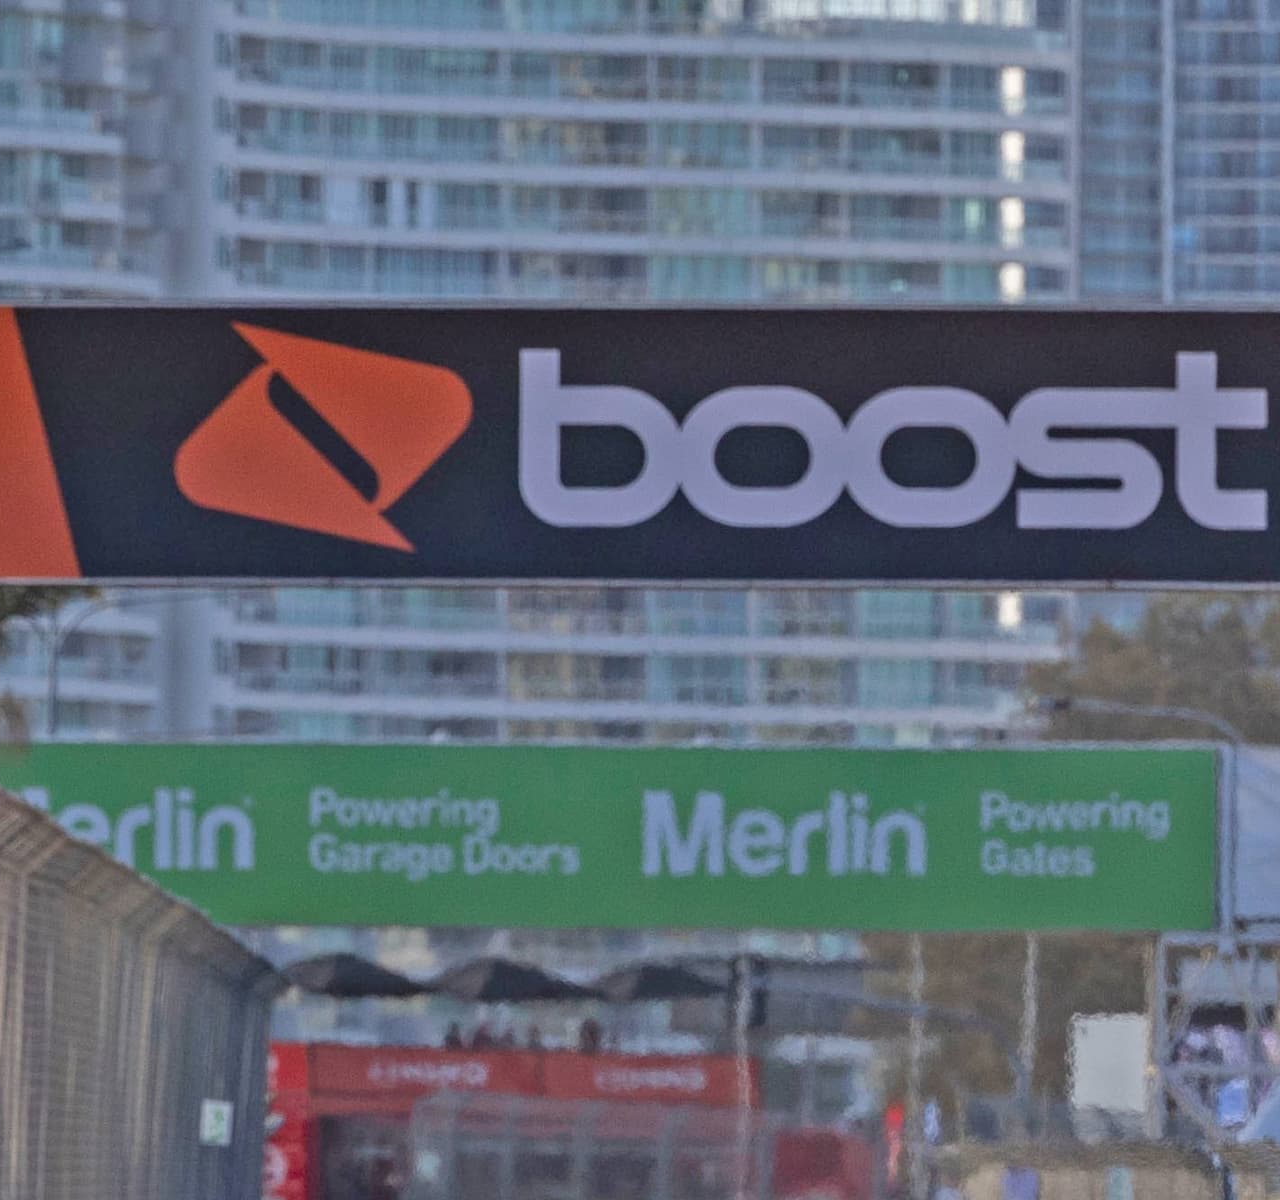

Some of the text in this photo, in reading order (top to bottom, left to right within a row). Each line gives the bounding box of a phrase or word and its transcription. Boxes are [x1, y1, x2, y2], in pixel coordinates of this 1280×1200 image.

[23, 785, 255, 870] erlin
[309, 787, 500, 837] Powering
[641, 790, 927, 877] Merlin
[980, 792, 1170, 840] Powering
[309, 832, 580, 881] Garage Doors
